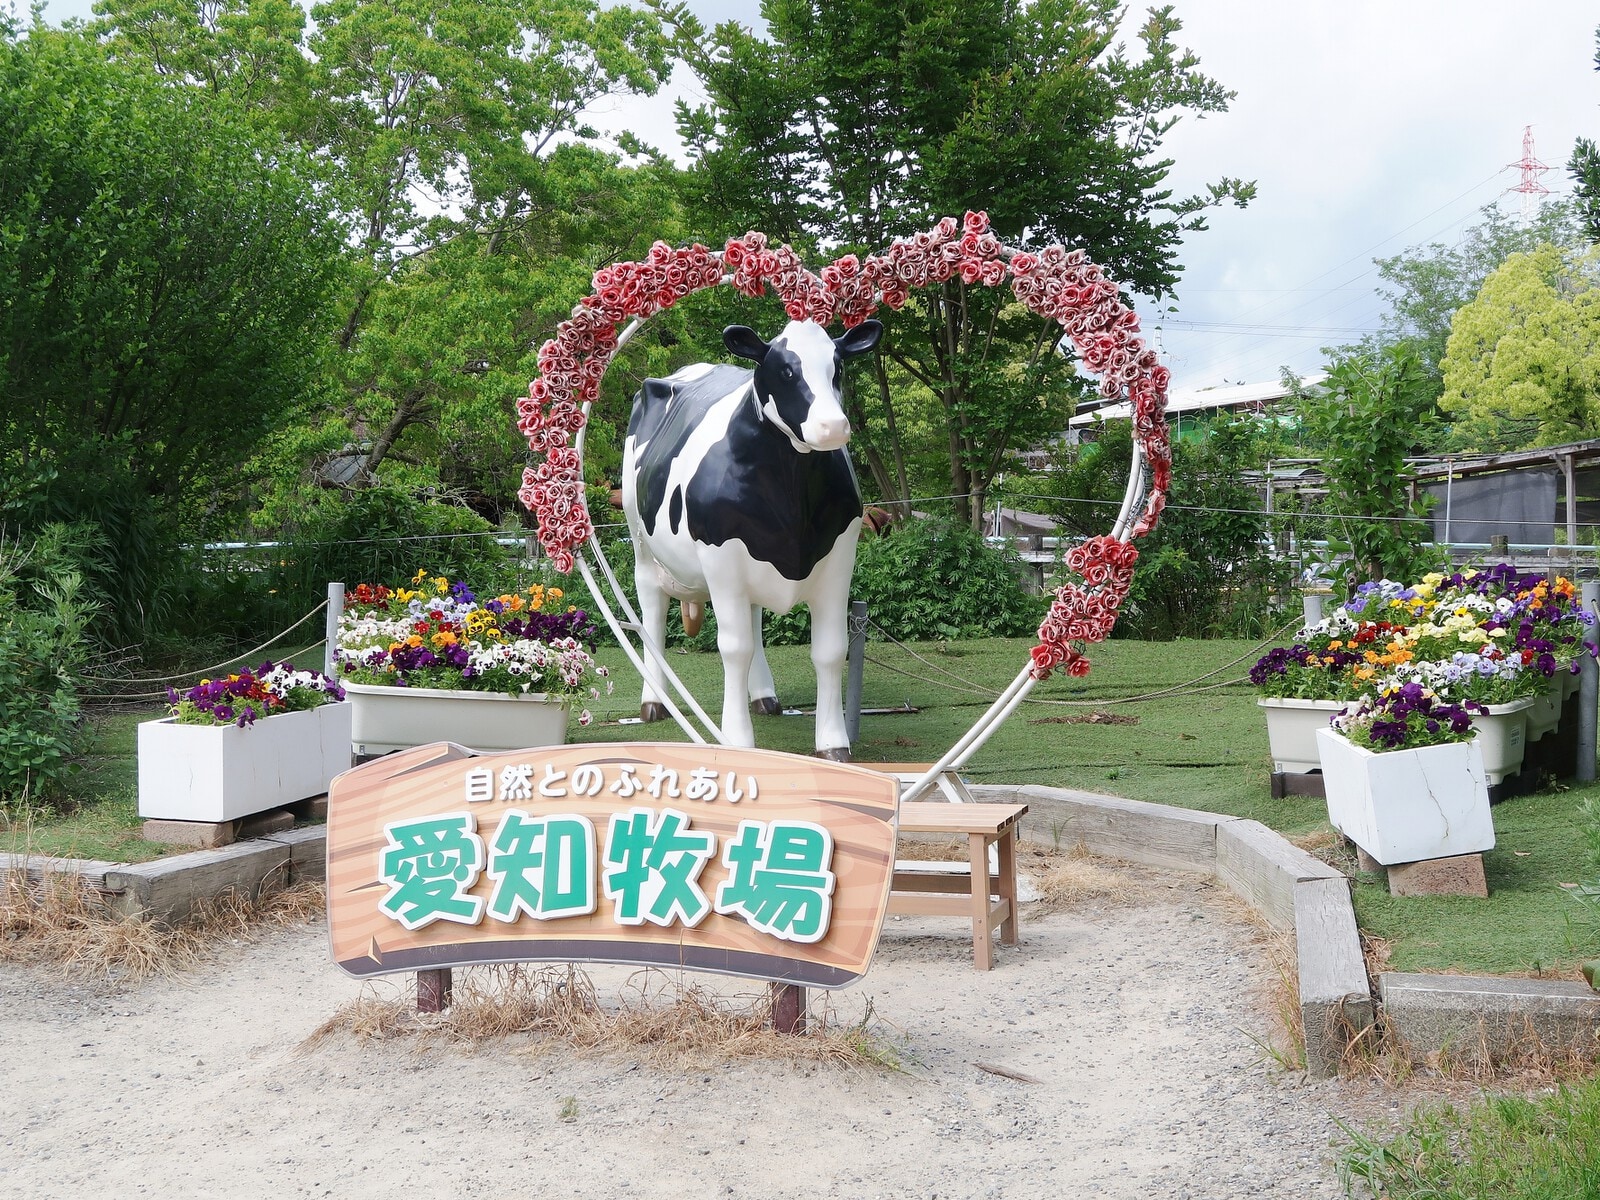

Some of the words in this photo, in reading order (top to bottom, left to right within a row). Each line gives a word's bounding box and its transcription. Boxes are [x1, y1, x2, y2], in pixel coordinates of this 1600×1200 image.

[465, 764, 759, 803] 自然とのふれあい
[379, 808, 837, 943] 愛知牧場
